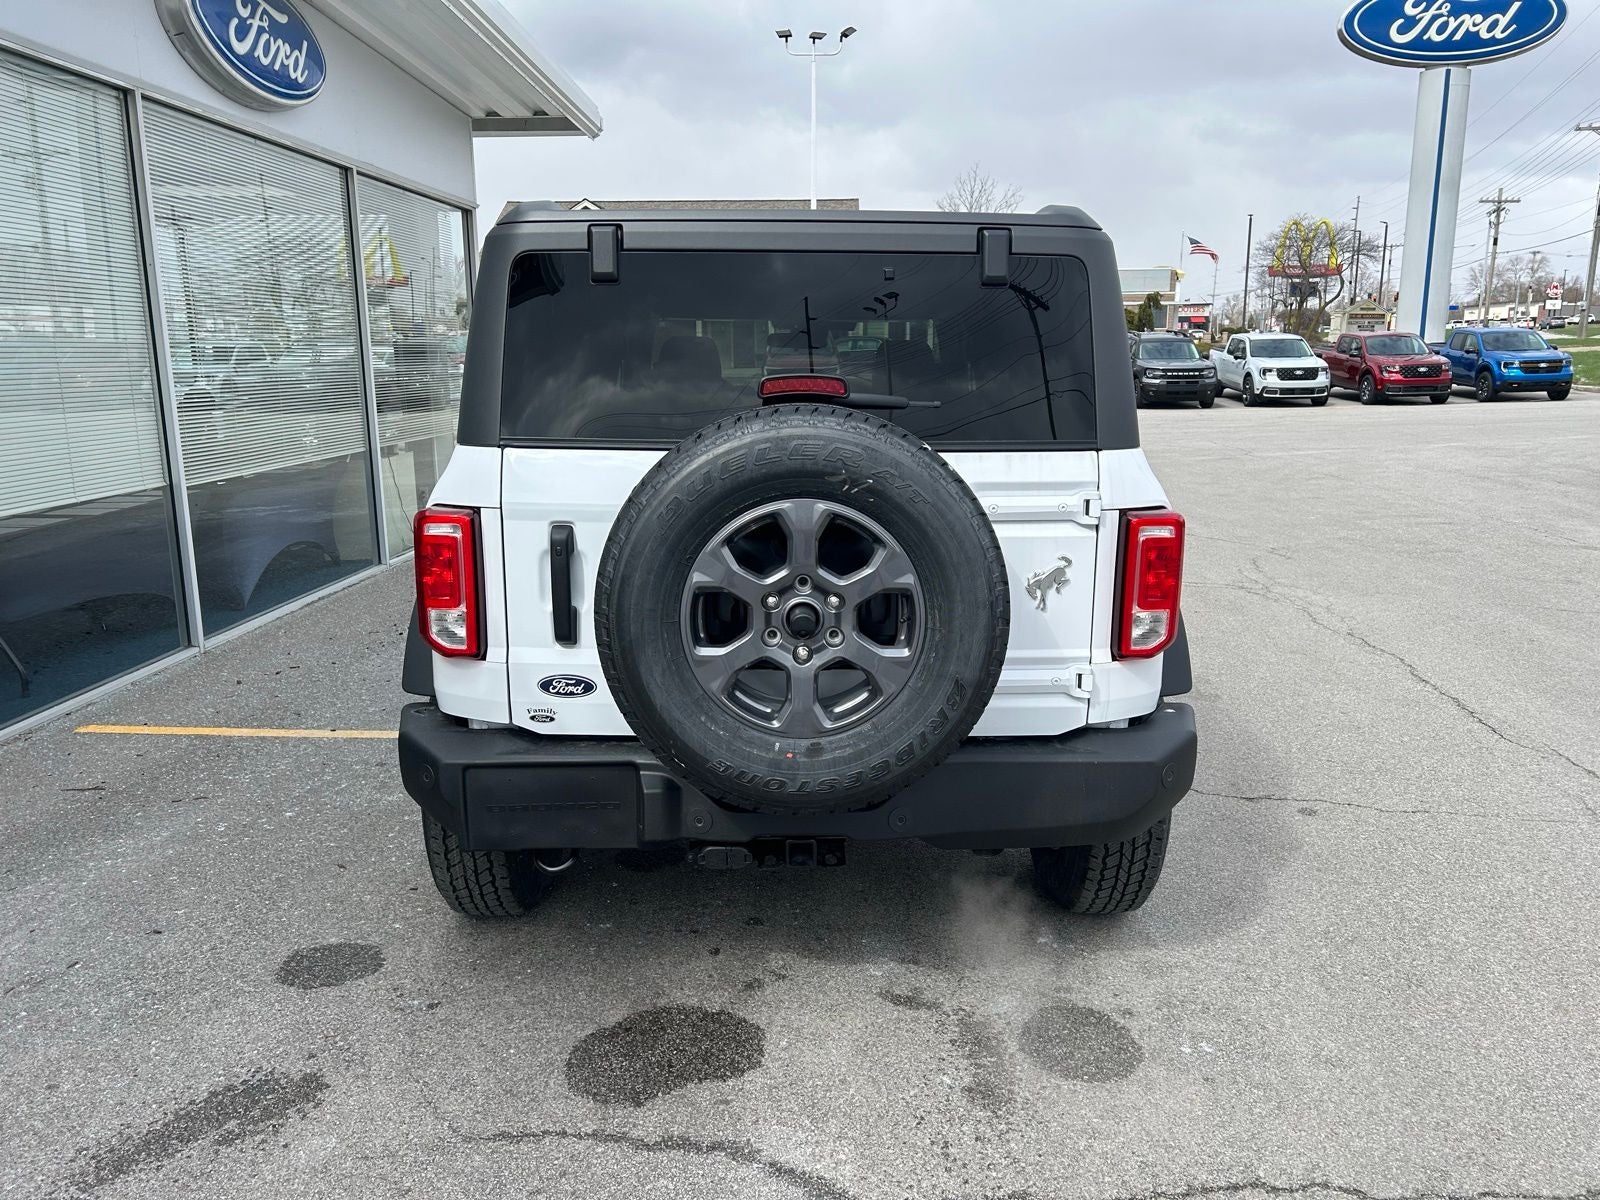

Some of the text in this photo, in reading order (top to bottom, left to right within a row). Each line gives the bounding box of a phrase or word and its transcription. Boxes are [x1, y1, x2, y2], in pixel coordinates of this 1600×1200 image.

[1389, 0, 1523, 44] Ford
[228, 0, 308, 84] Ford
[549, 678, 585, 694] Ford
[526, 707, 558, 716] Family
[533, 714, 551, 722] Ford
[704, 674, 969, 795] BRIDGESTONE
